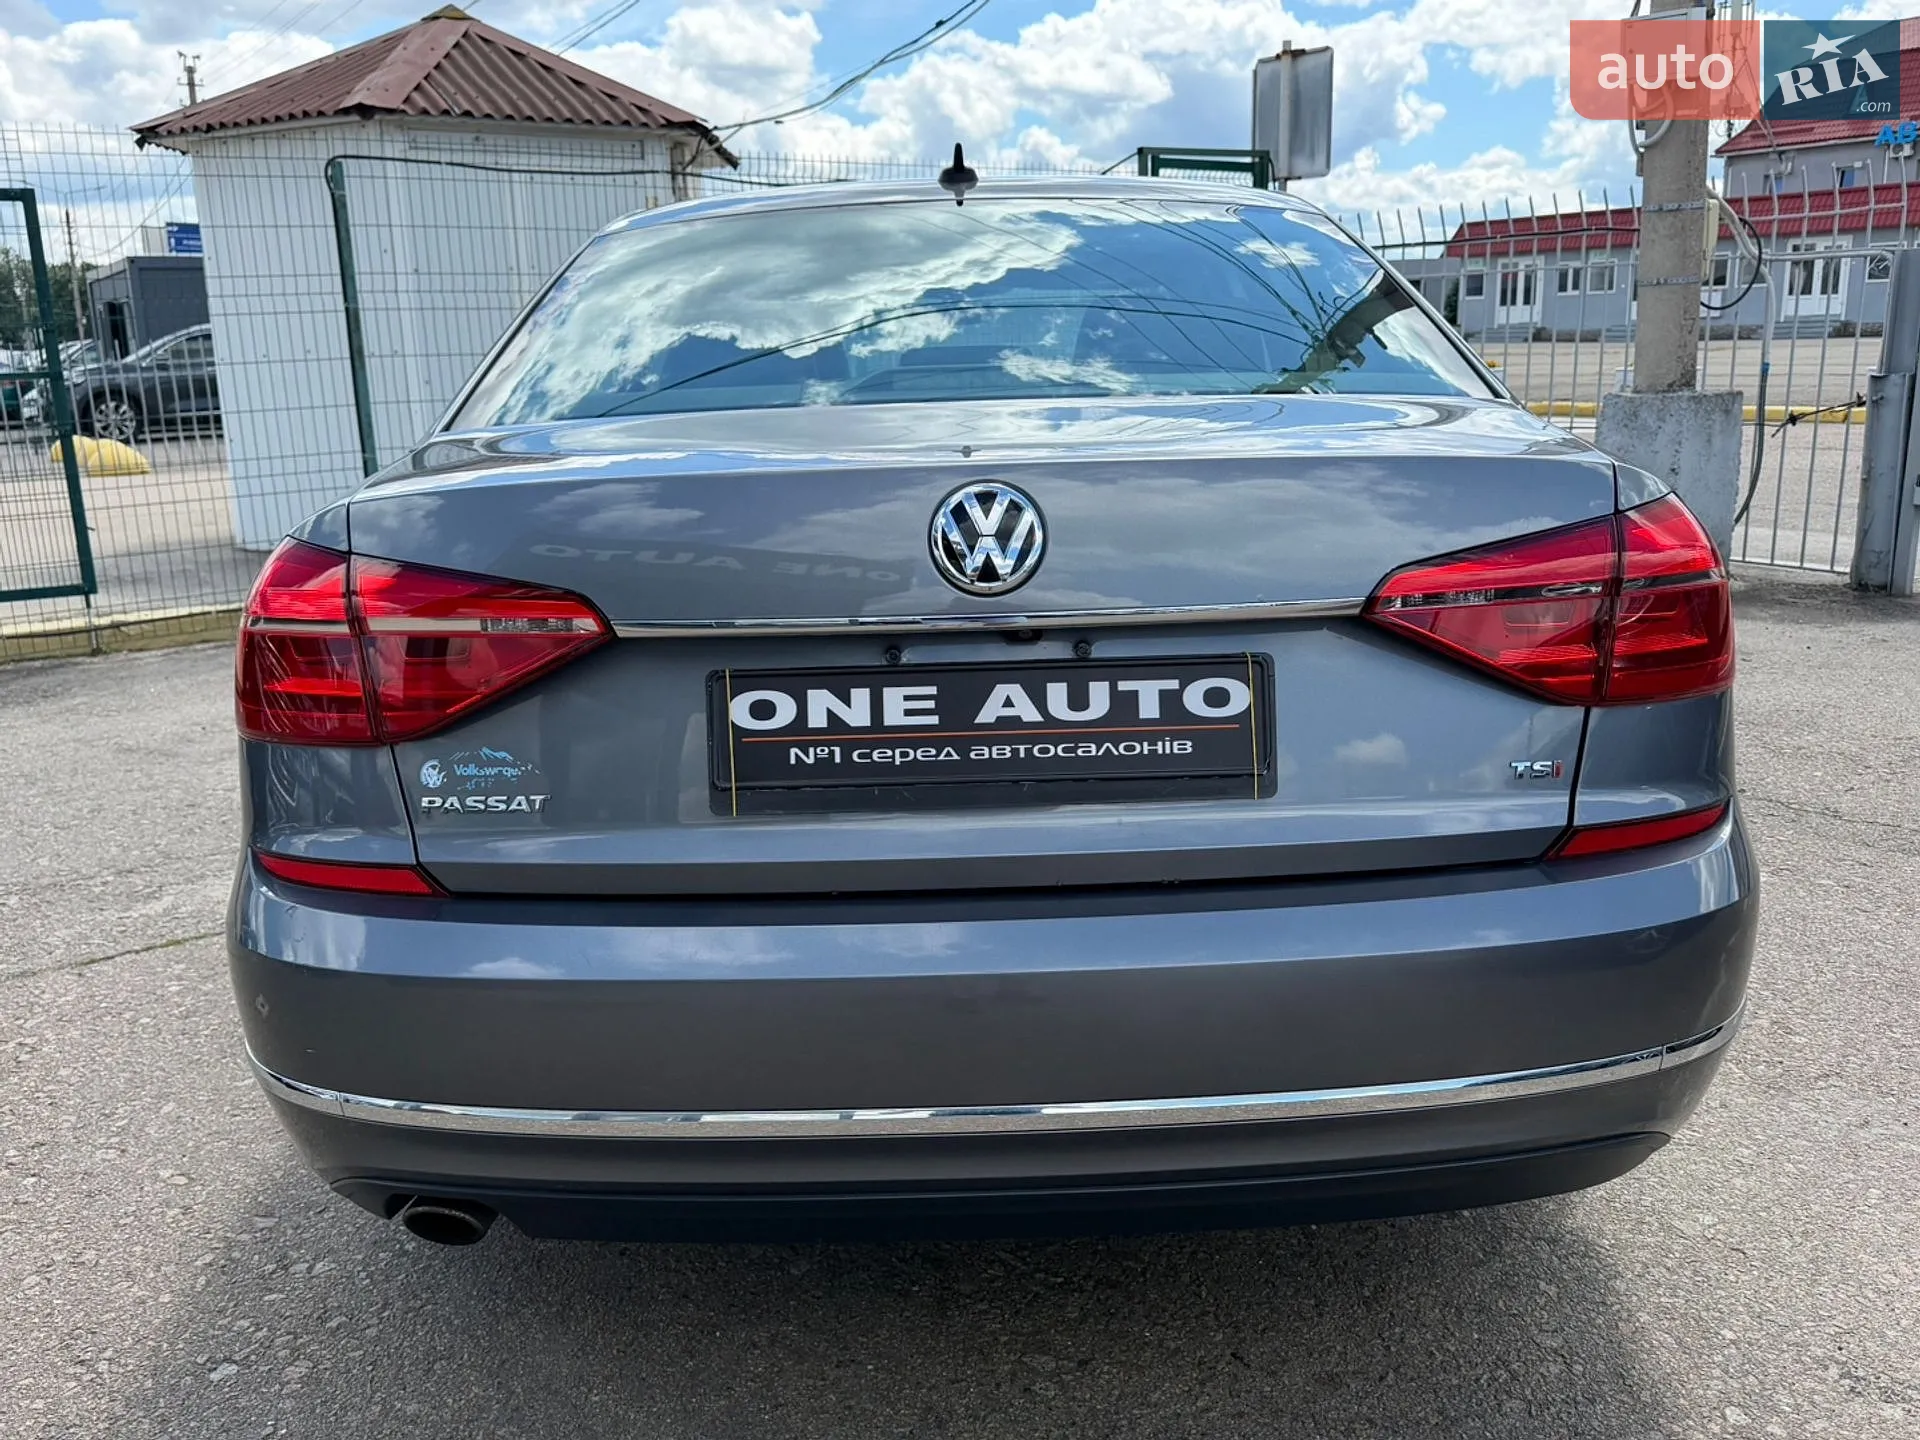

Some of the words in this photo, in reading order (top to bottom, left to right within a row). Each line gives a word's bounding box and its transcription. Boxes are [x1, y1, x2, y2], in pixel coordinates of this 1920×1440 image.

[730, 685, 940, 731] ONE
[974, 677, 1250, 724] AUTO
[852, 746, 960, 765] серед
[969, 737, 1194, 760] автосалонів
[420, 794, 550, 814] PASSAT
